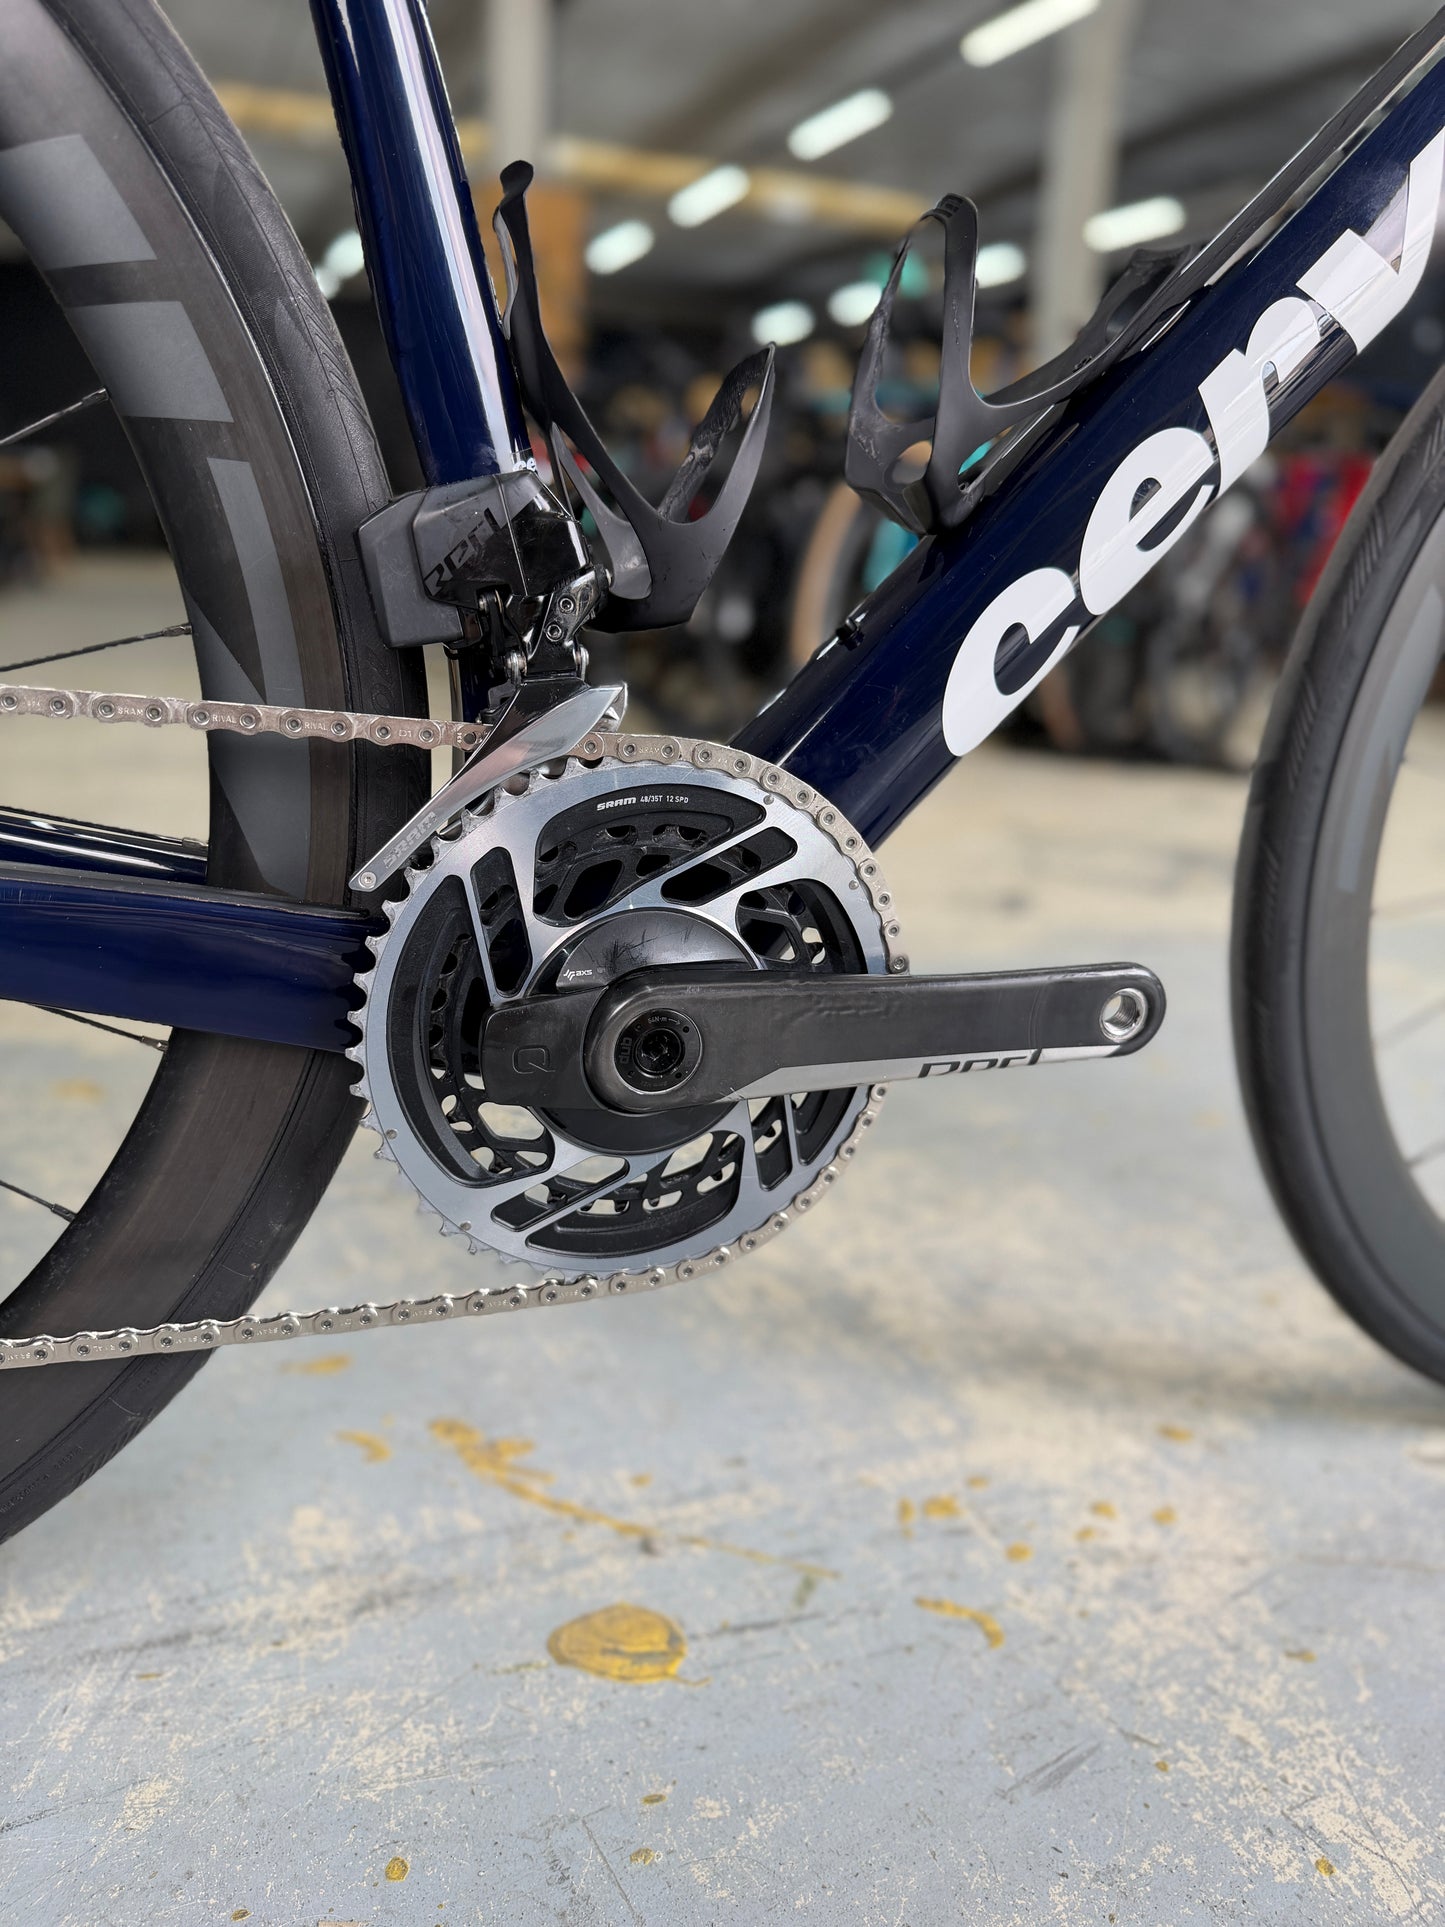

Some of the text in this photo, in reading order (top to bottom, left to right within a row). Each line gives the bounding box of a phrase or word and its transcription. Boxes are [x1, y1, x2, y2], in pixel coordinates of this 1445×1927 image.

[118, 708, 143, 716] SRAM
[212, 715, 237, 723] RIVAL
[305, 722, 328, 731] RIVAL
[597, 797, 637, 811] SRAM
[640, 795, 663, 803] 48/35T
[675, 796, 689, 804] SPD
